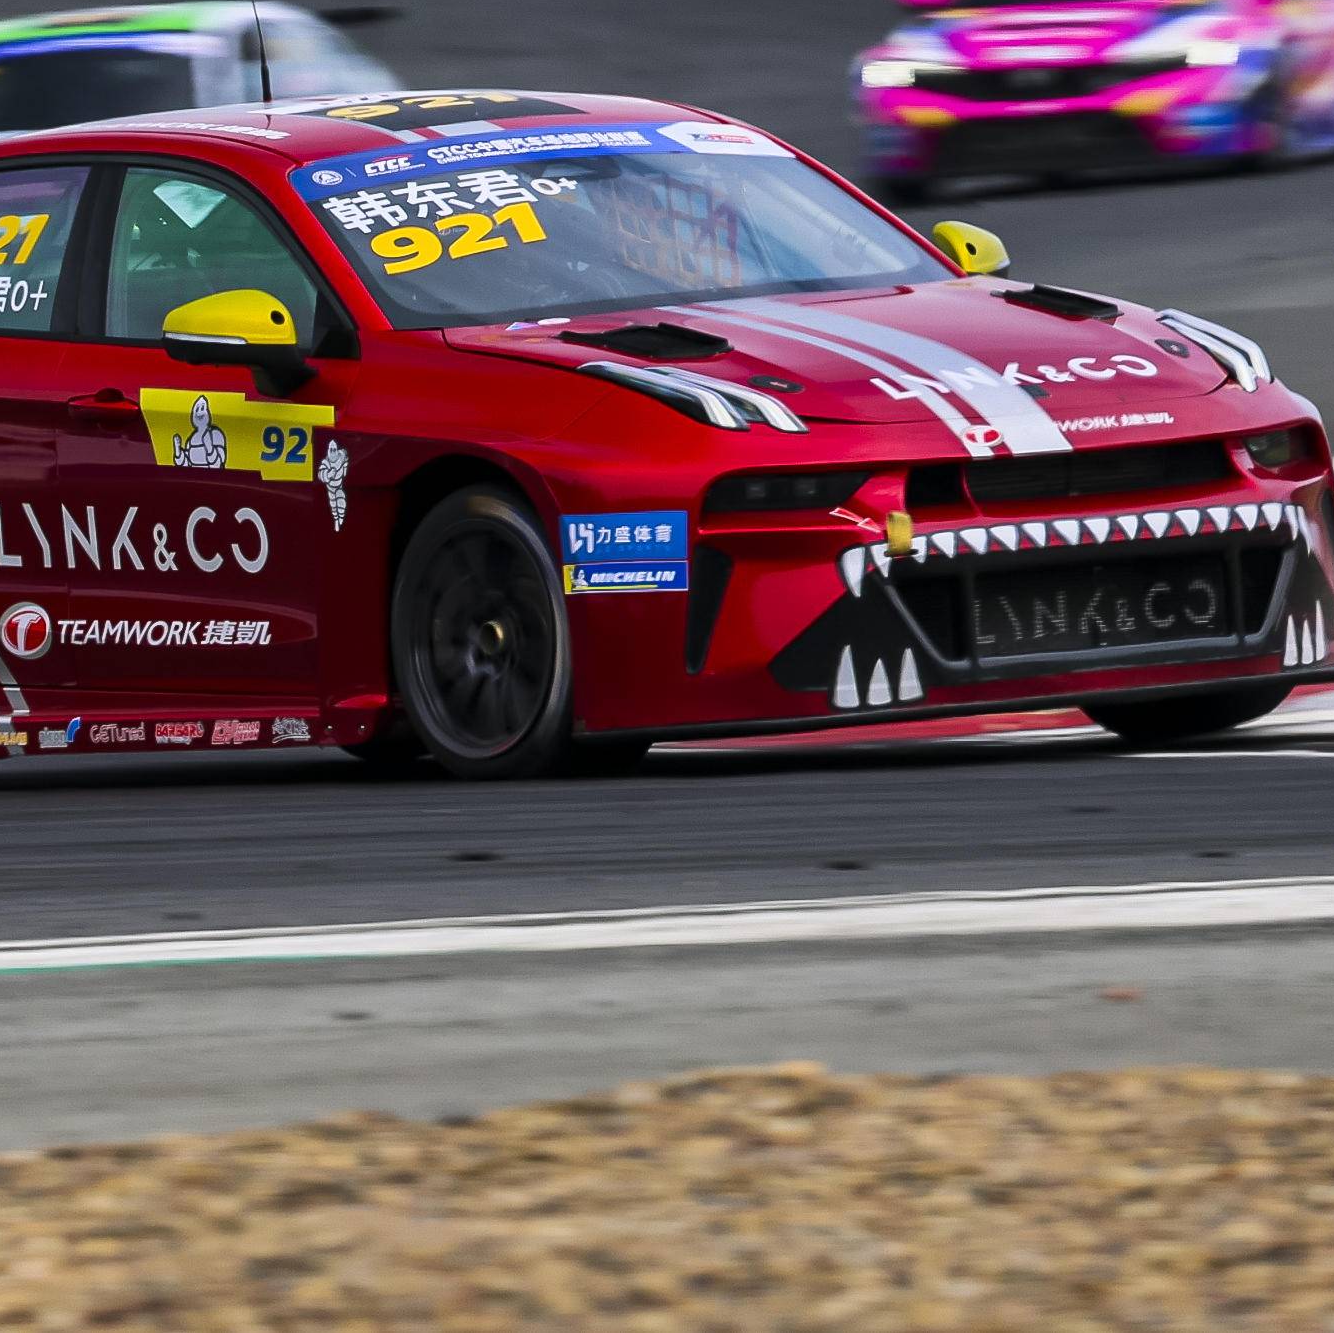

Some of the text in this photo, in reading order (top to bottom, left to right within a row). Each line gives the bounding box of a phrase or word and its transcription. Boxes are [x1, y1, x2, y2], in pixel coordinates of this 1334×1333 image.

[325, 91, 520, 119] 921
[364, 157, 412, 175] CTCC
[370, 202, 547, 275] 921
[260, 425, 308, 464] 92
[596, 524, 672, 544] 力盛体育
[591, 570, 676, 583] MICHELIN
[57, 619, 200, 646] TEAMWORK
